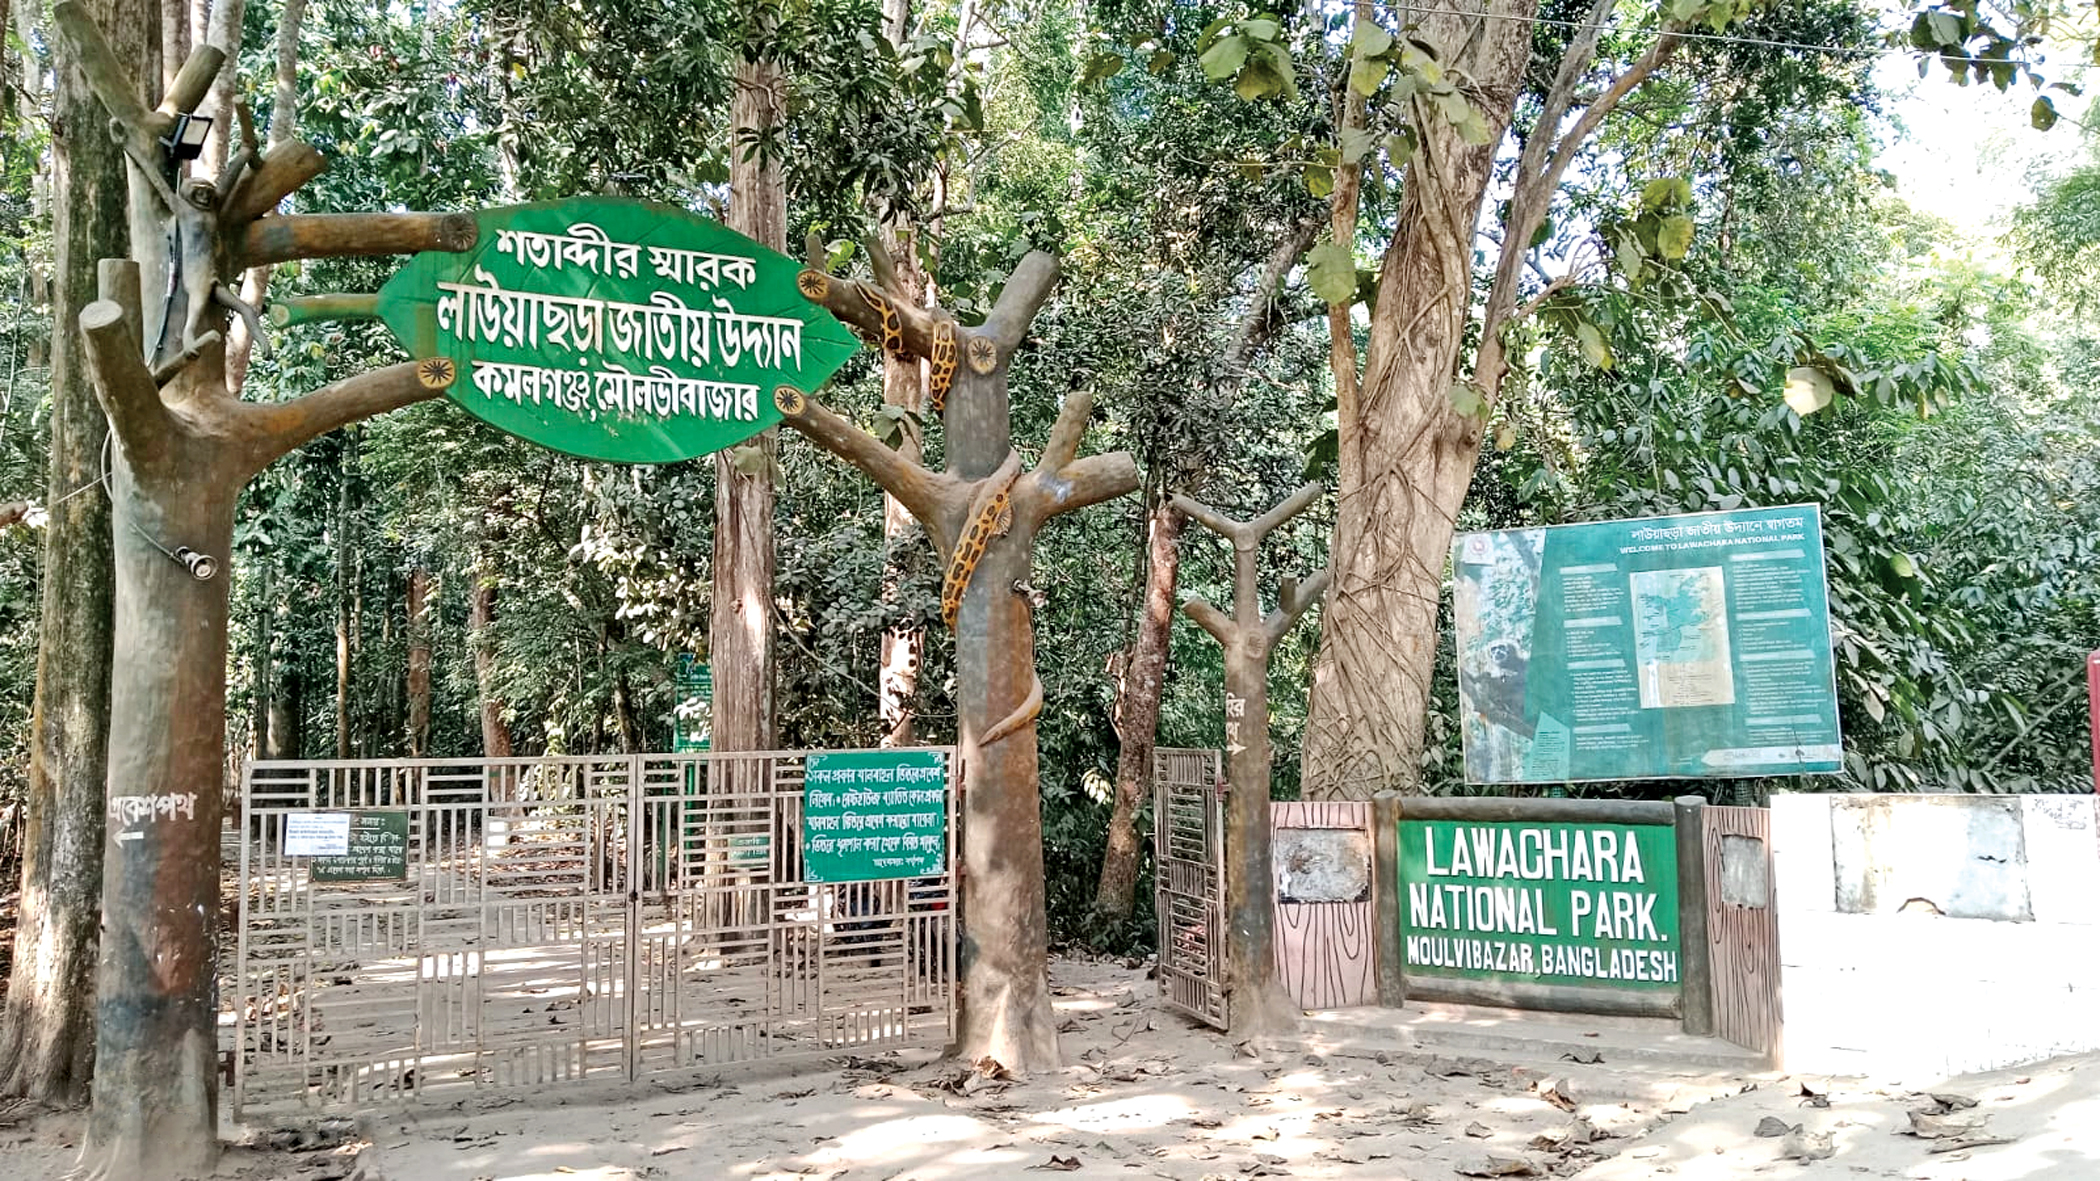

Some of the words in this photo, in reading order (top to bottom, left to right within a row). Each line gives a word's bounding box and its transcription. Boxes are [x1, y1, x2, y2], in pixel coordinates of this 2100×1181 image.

[496, 223, 640, 278] শতাব্দীর
[647, 245, 757, 291] স্মারক
[437, 264, 605, 366] লাউয়াছড়া
[608, 291, 712, 367] জাতীয়
[711, 294, 804, 372] উদ্যান
[1620, 543, 1664, 555] WELCOME
[1664, 542, 1677, 551] TO
[1679, 538, 1734, 550] LAWACHARA
[1734, 534, 1780, 545] NATIONAL
[1781, 533, 1805, 542] PARK
[1686, 520, 1721, 537] জাতীয়
[1723, 519, 1763, 533] উদ্যানে
[857, 767, 894, 783] যানবাহন
[1425, 826, 1645, 884] LAWACHARA
[1409, 882, 1557, 936] NATIONAL
[1570, 889, 1669, 942] PARK.
[1541, 944, 1677, 983] BANGLADESH
